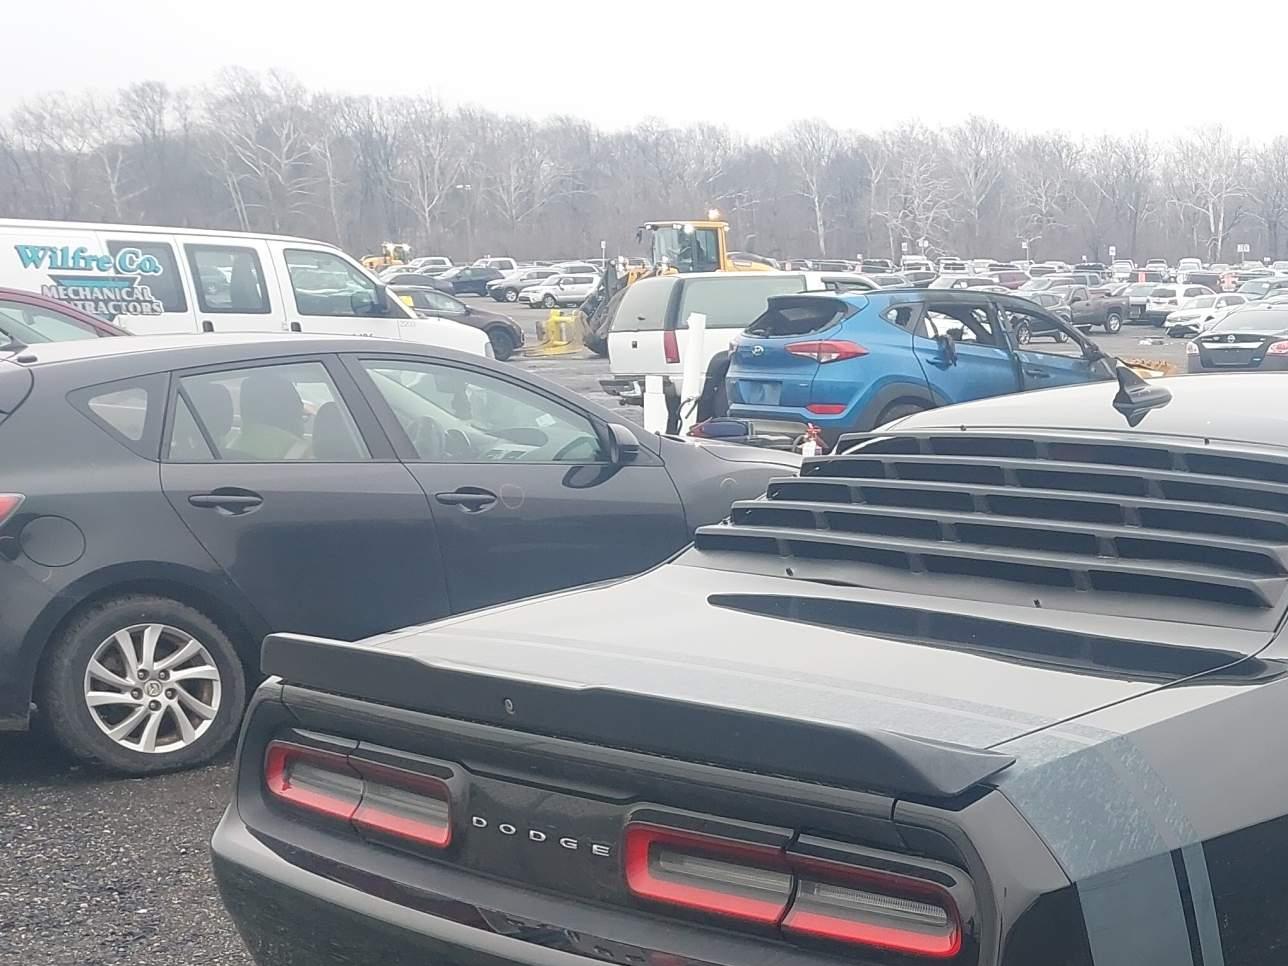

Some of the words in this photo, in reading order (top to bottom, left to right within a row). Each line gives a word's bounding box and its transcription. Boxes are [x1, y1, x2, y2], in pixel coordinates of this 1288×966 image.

[14, 244, 113, 273] Wilfre
[117, 248, 162, 275] Co.
[41, 284, 153, 302] MECHANICAL
[472, 816, 610, 857] DODGE
